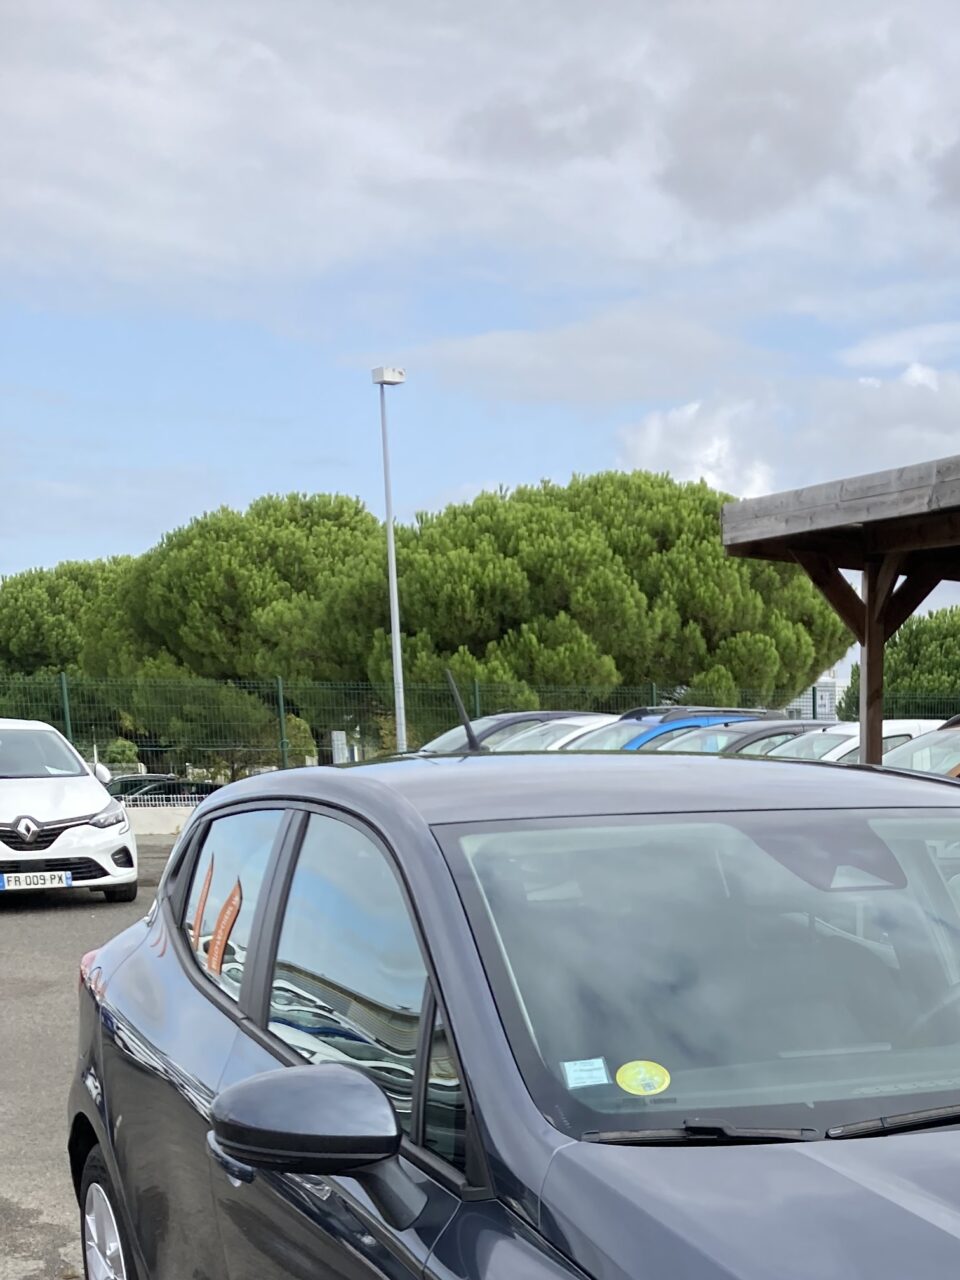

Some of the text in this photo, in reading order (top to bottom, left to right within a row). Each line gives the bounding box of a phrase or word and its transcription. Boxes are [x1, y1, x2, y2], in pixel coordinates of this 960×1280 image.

[6, 873, 64, 886] FR 009 PX
